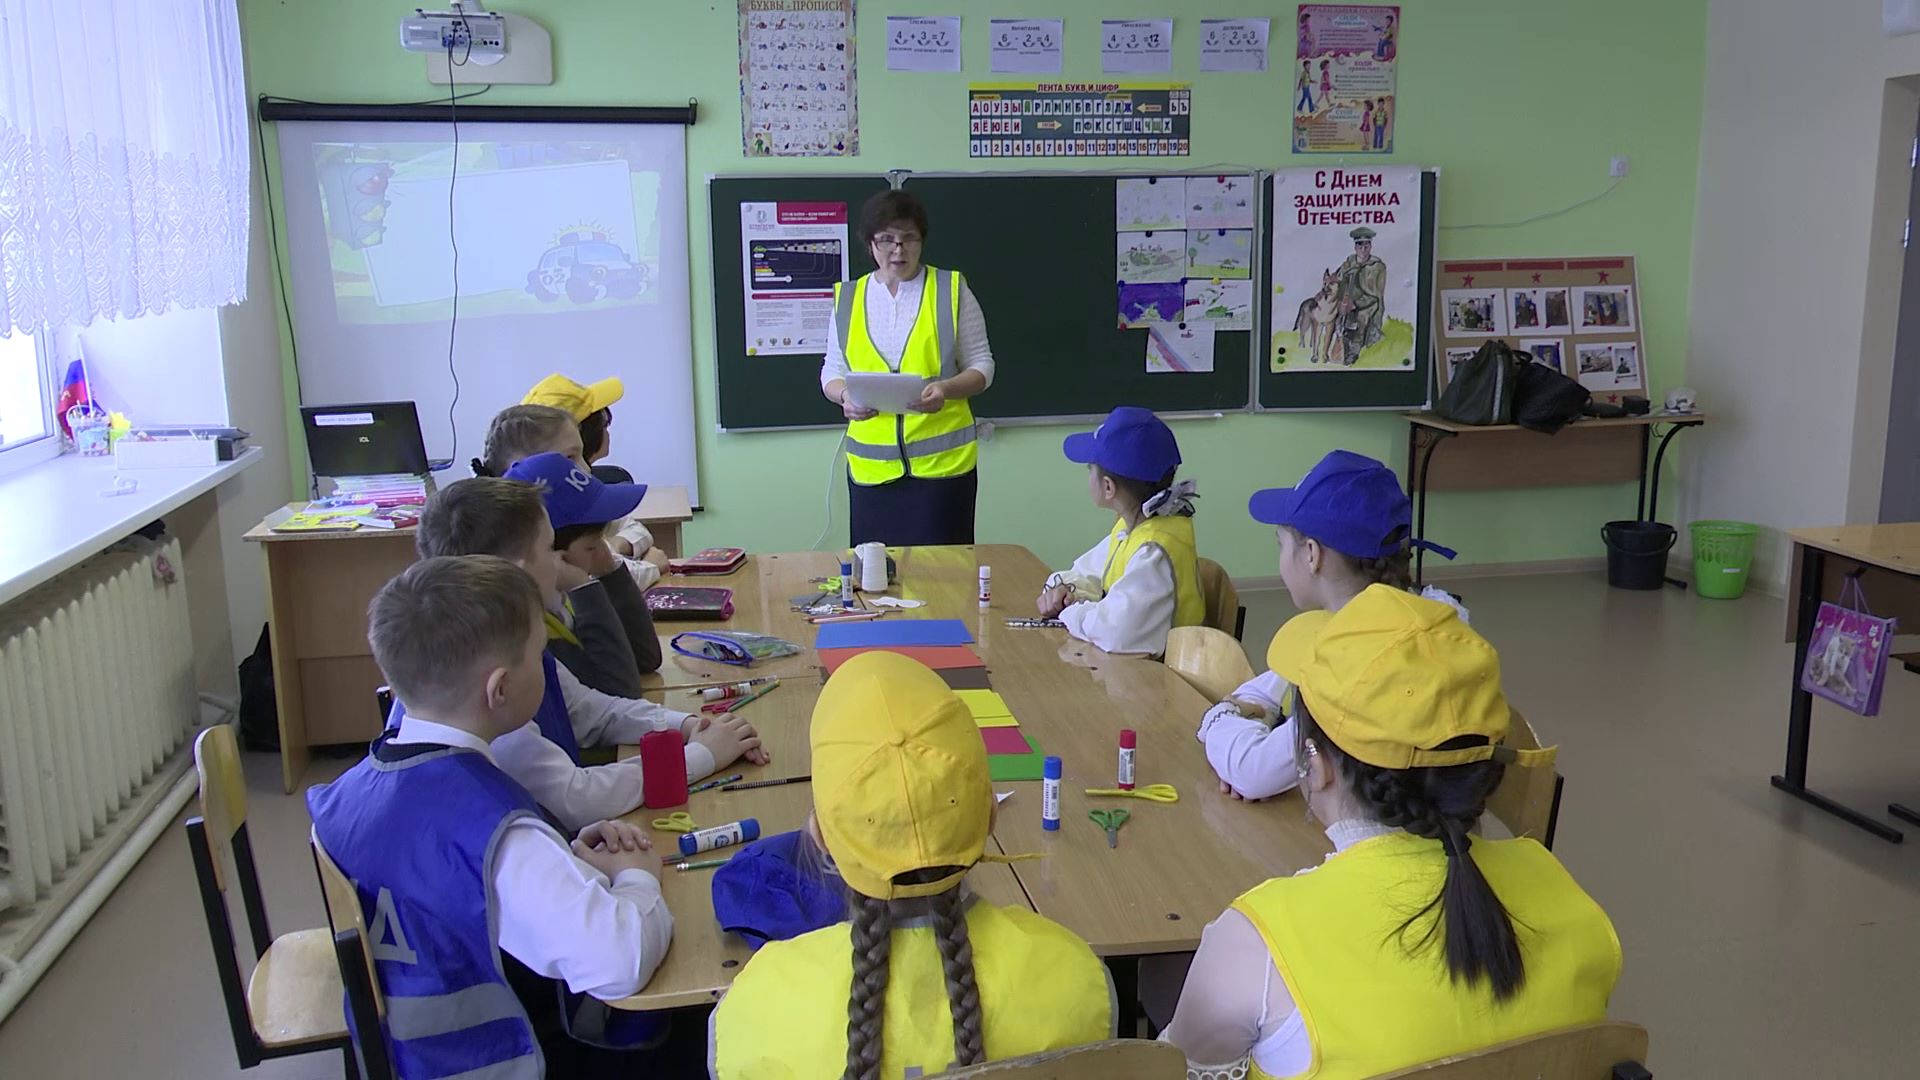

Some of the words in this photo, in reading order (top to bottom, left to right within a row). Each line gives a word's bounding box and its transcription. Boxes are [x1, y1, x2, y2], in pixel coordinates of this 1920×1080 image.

[751, 0, 784, 11] БУКВЫ
[793, 0, 843, 11] ПРОПИСИ
[896, 31, 902, 39] 4
[920, 31, 927, 40] 3
[1001, 33, 1008, 42] 6
[1025, 33, 1032, 42] 2
[1110, 34, 1116, 42] 4
[1130, 33, 1137, 43] 3
[1232, 31, 1238, 40] 2
[1038, 84, 1063, 92] ЛЕНТА
[1065, 84, 1086, 92] БУКВ
[1088, 84, 1094, 92] И
[1096, 84, 1119, 92] ЦИФР
[1315, 170, 1326, 188] С
[1294, 192, 1400, 208] ЗАЩИТНИКА
[1298, 208, 1395, 225] ОТЕЧЕСТВА
